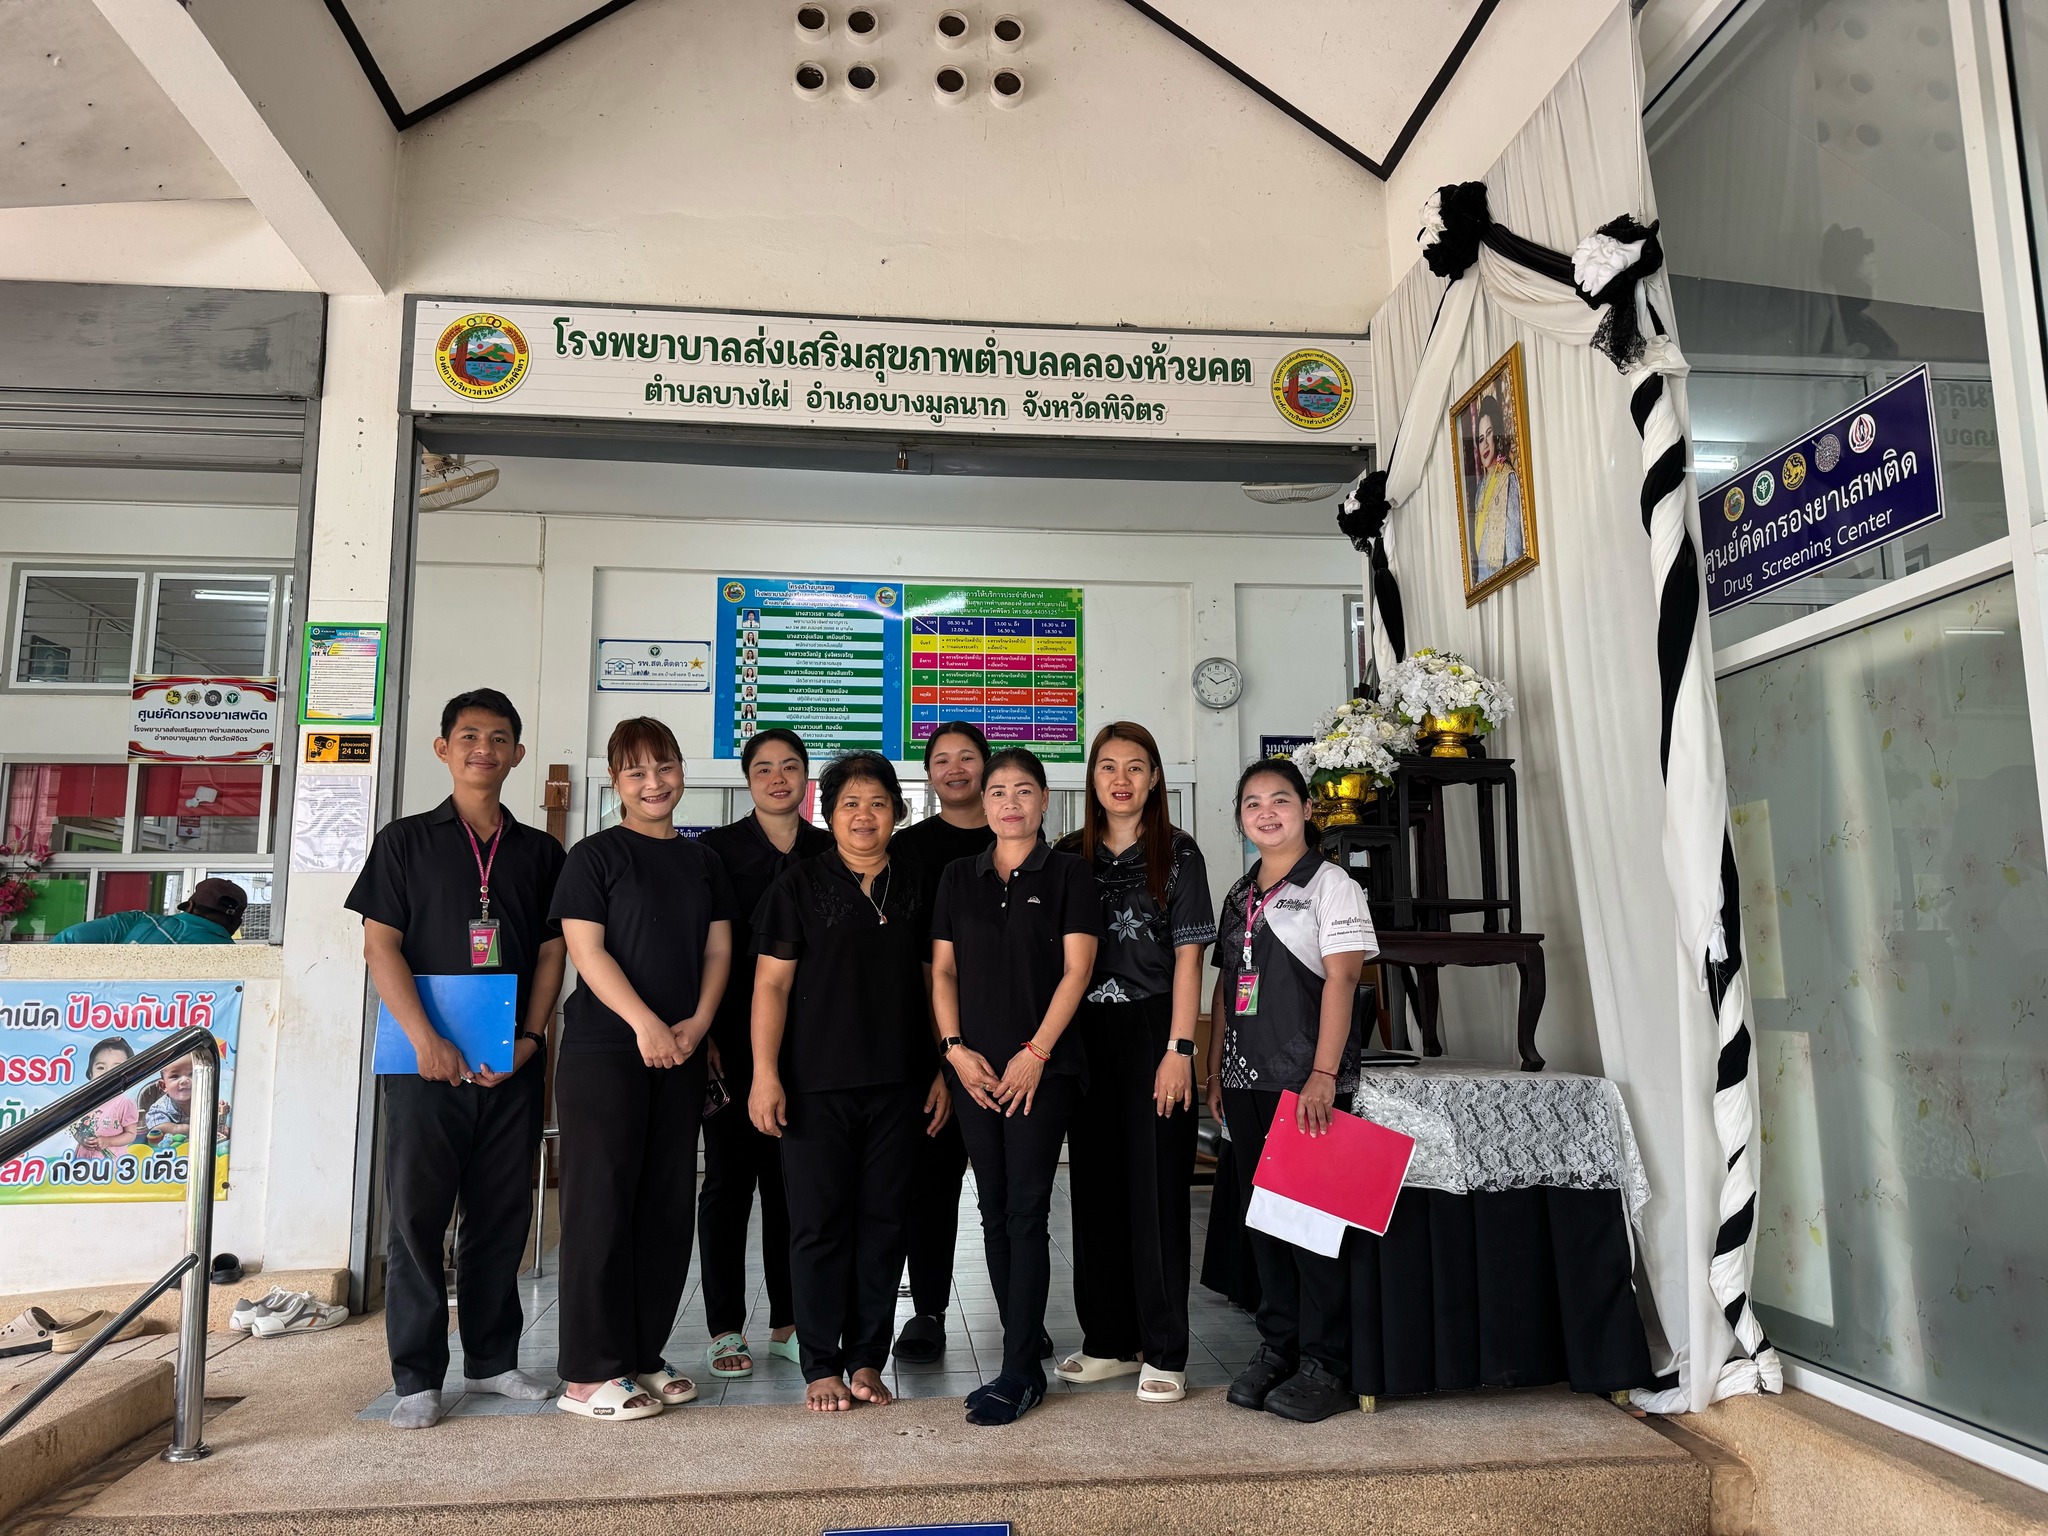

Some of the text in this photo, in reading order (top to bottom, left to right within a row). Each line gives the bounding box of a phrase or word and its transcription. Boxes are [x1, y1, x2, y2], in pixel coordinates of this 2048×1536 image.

[555, 317, 1252, 384] โรงพยาบาลส่งเสริมสุขภาพตำบลคลองห้วยคต
[645, 374, 1166, 424] ตำบลบางไผ่ อำเภอบางมูลนาก จังหวัดพิจิตร
[1703, 448, 1918, 584] ศูนย์คัดกรองยาเสพติด
[1723, 508, 1893, 597] Drug Screening Center
[134, 725, 269, 735] โรงพยาบาลส่งเสริมสุขภาพตำบลคลองห้วยคต
[138, 708, 267, 722] ศูนย์คัดกรองยาเสพติด
[209, 734, 248, 742] จังหวัดพิจิตร
[67, 994, 214, 1029] ป้องกันได้
[0, 1048, 74, 1082] รรภ์
[52, 1152, 109, 1181] ก่อน
[119, 1159, 135, 1181] 3
[145, 1152, 188, 1181] เดือ
